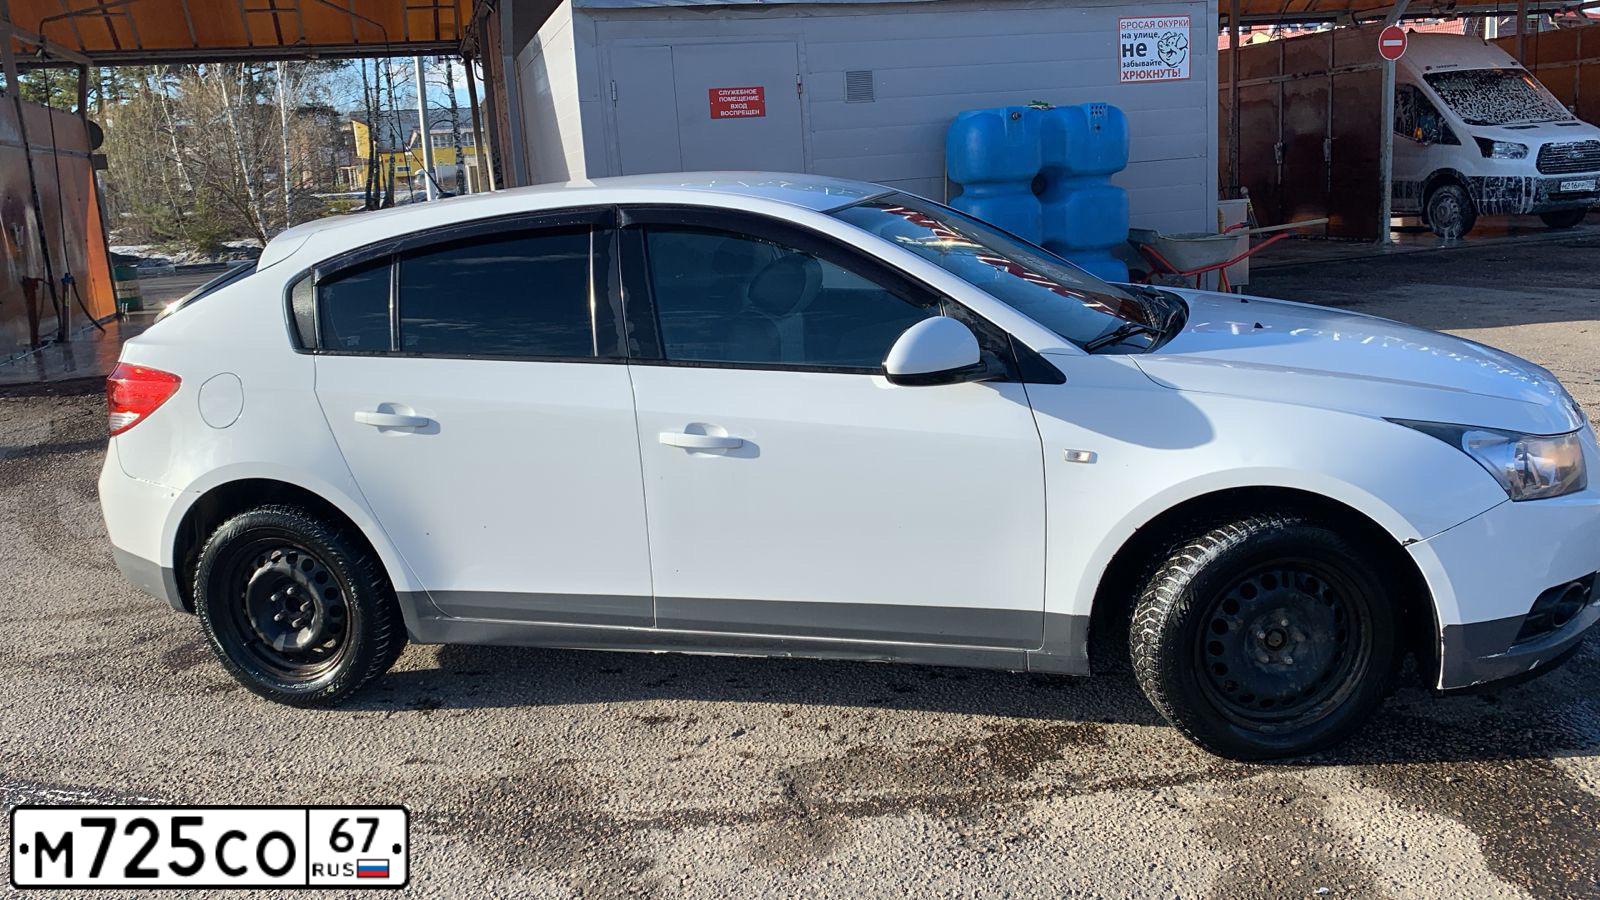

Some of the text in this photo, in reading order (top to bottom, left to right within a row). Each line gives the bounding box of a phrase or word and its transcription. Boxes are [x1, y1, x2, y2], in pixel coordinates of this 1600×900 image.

[1121, 20, 1189, 29] БРОСАЯ ОКУРКИ
[1134, 32, 1160, 40] улице,
[1122, 42, 1147, 57] не
[1123, 60, 1162, 68] забывайте
[1122, 69, 1181, 80] ХРЮКНУТЬ!
